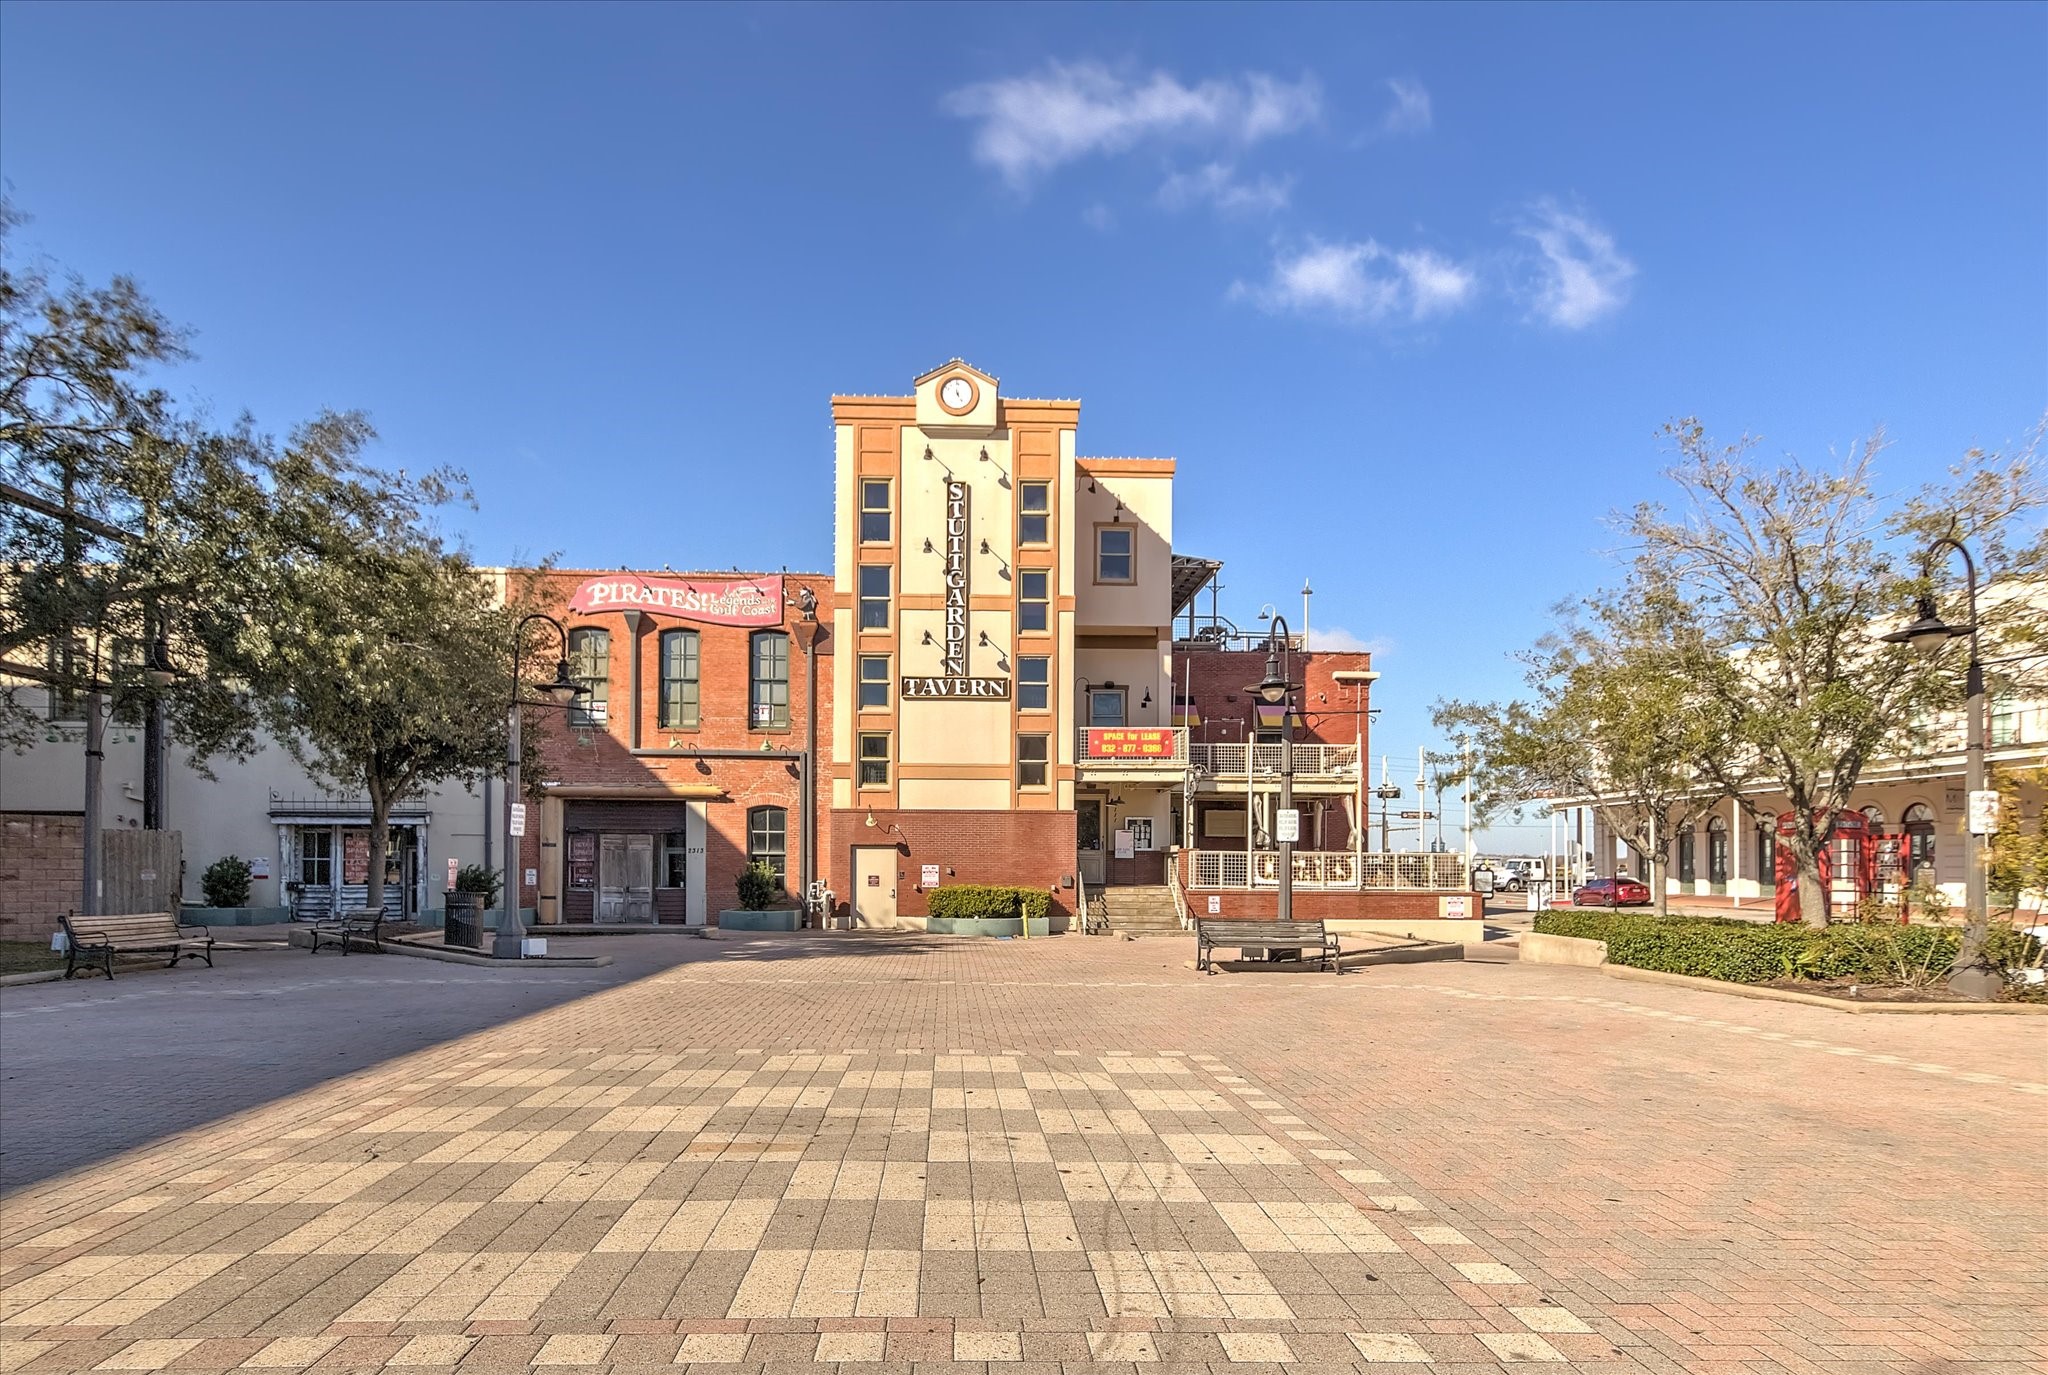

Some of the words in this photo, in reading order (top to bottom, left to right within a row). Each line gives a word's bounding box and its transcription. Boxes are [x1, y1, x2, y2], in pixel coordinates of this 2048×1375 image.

[946, 482, 967, 676] STUTTGARDEN
[586, 582, 708, 612] PIRATES!
[710, 592, 761, 606] Legends
[709, 603, 739, 616] Gulf
[741, 603, 776, 616] Coast
[903, 678, 1005, 697] TAVERN
[1103, 732, 1125, 741] SPACE
[1127, 732, 1138, 741] for
[1141, 732, 1161, 741] LEASE
[1122, 744, 1137, 753] 877
